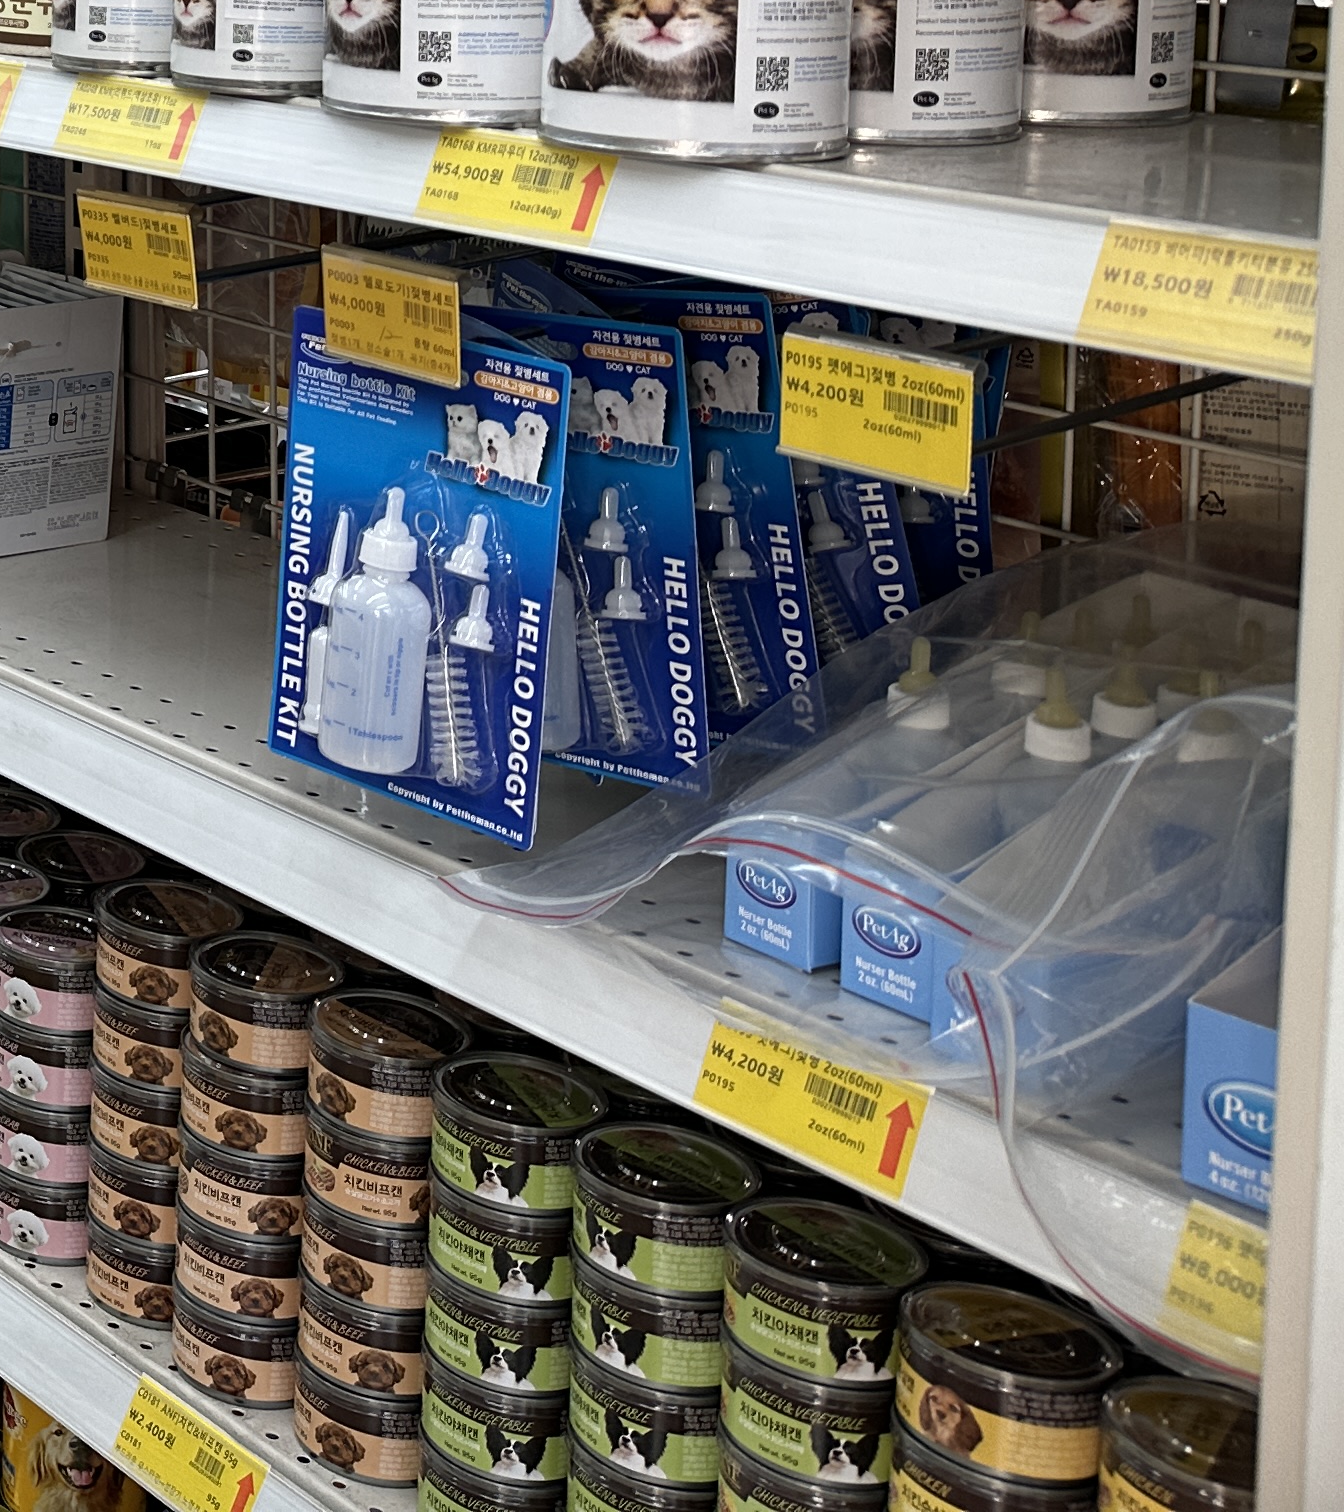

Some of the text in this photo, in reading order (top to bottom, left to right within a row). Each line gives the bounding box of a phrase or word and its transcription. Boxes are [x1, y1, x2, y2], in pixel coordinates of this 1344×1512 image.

[441, 136, 474, 153] TA0168
[528, 149, 580, 168] 12oz(340g)
[424, 185, 459, 202] TA0168
[509, 199, 562, 220] 12oz(340g)
[1114, 235, 1161, 254] TA0159
[327, 268, 359, 285] P0003
[1095, 298, 1148, 318] TA0159
[297, 361, 347, 386] Nursing
[351, 375, 393, 396] bottle
[784, 349, 823, 370] P0195
[900, 372, 966, 405] 2oz(60ml)
[494, 392, 537, 410] DOG CAT
[784, 400, 819, 419] P0195
[862, 417, 923, 444] 2oz(60ml)
[856, 481, 899, 576] HELLO
[276, 442, 316, 748] NURSING BOTTLE KIT
[662, 557, 698, 768] HELLO DOGGY
[504, 598, 541, 819] HELLO DOGGY
[701, 1068, 736, 1093] P0195
[807, 1117, 867, 1155] 2oz(60ml)
[193, 1178, 243, 1209] 치킨비프캔
[343, 1172, 403, 1198] 치킨비프캔
[438, 1227, 487, 1264] 치킨야채캔
[750, 1305, 820, 1345] 치킨야채캔
[205, 1493, 221, 1510] 95g
